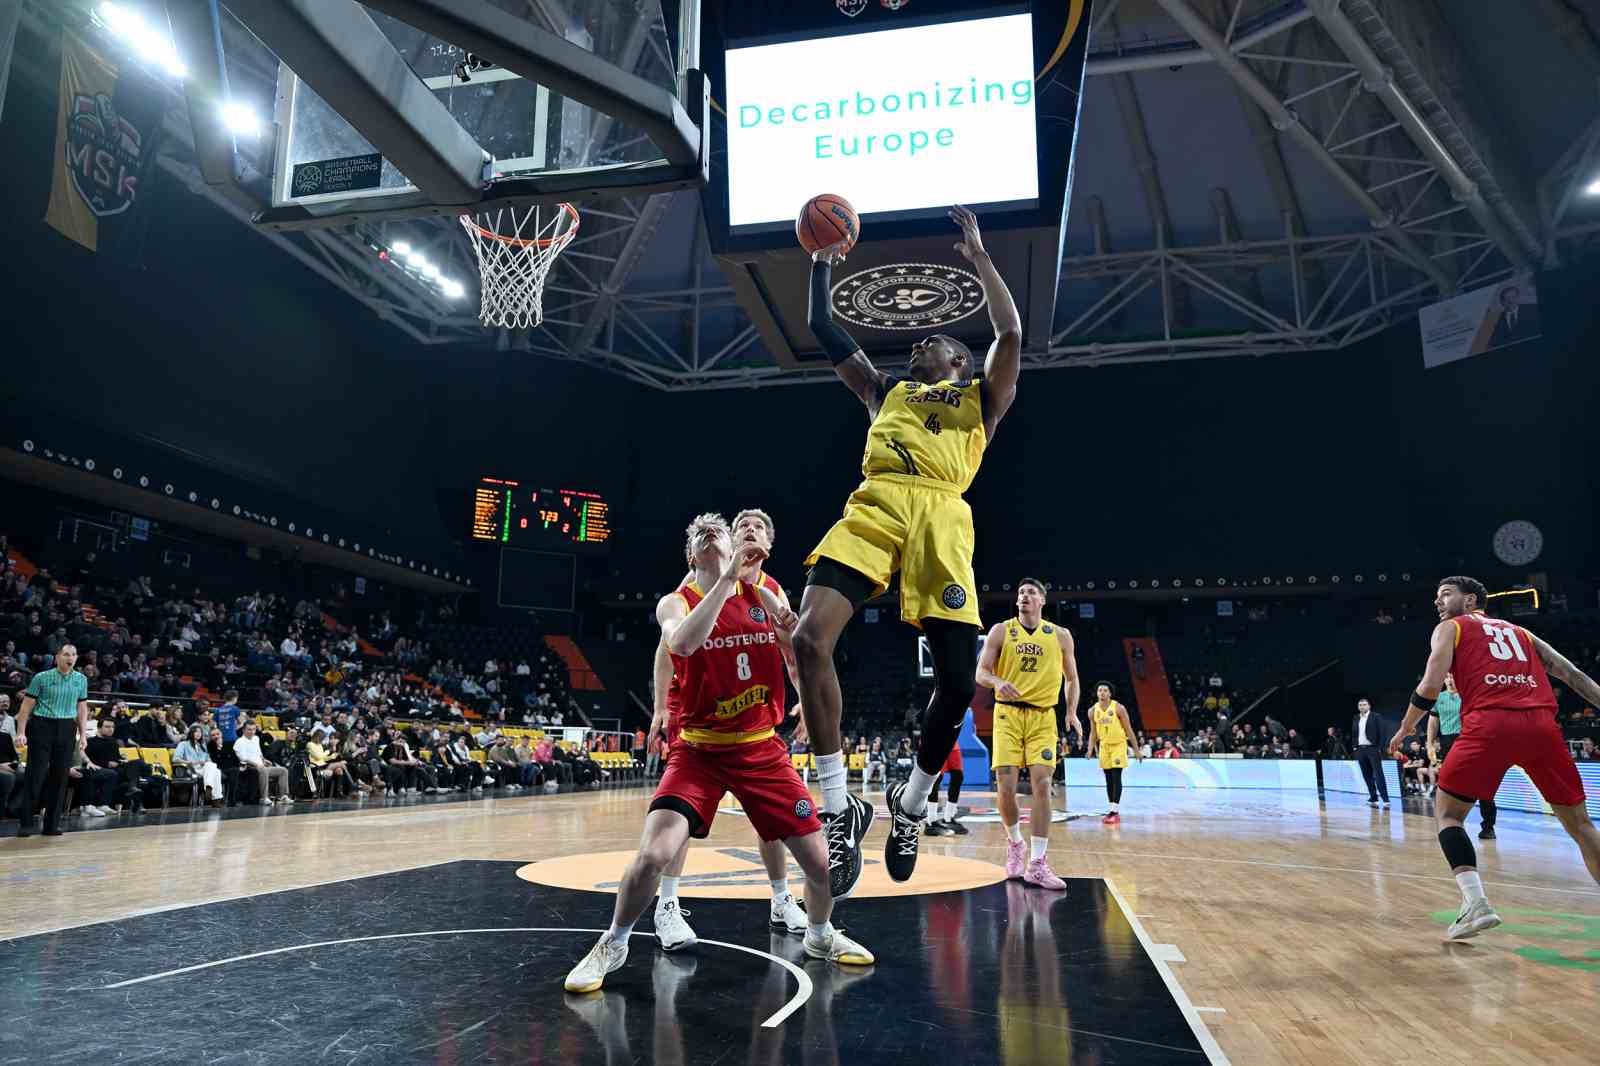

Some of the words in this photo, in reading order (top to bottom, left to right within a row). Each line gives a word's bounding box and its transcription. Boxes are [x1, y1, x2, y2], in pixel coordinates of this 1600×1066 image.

[739, 77, 1033, 129] Decarbonizing
[815, 127, 955, 159] Europe
[323, 163, 379, 177] CHAMPIONS
[905, 388, 963, 409] MSK
[924, 413, 942, 435] 4
[703, 632, 776, 651] OOSTENDE
[1016, 642, 1043, 656] MSK
[1482, 623, 1529, 662] 31
[736, 652, 752, 681] 8
[1020, 656, 1037, 672] 22
